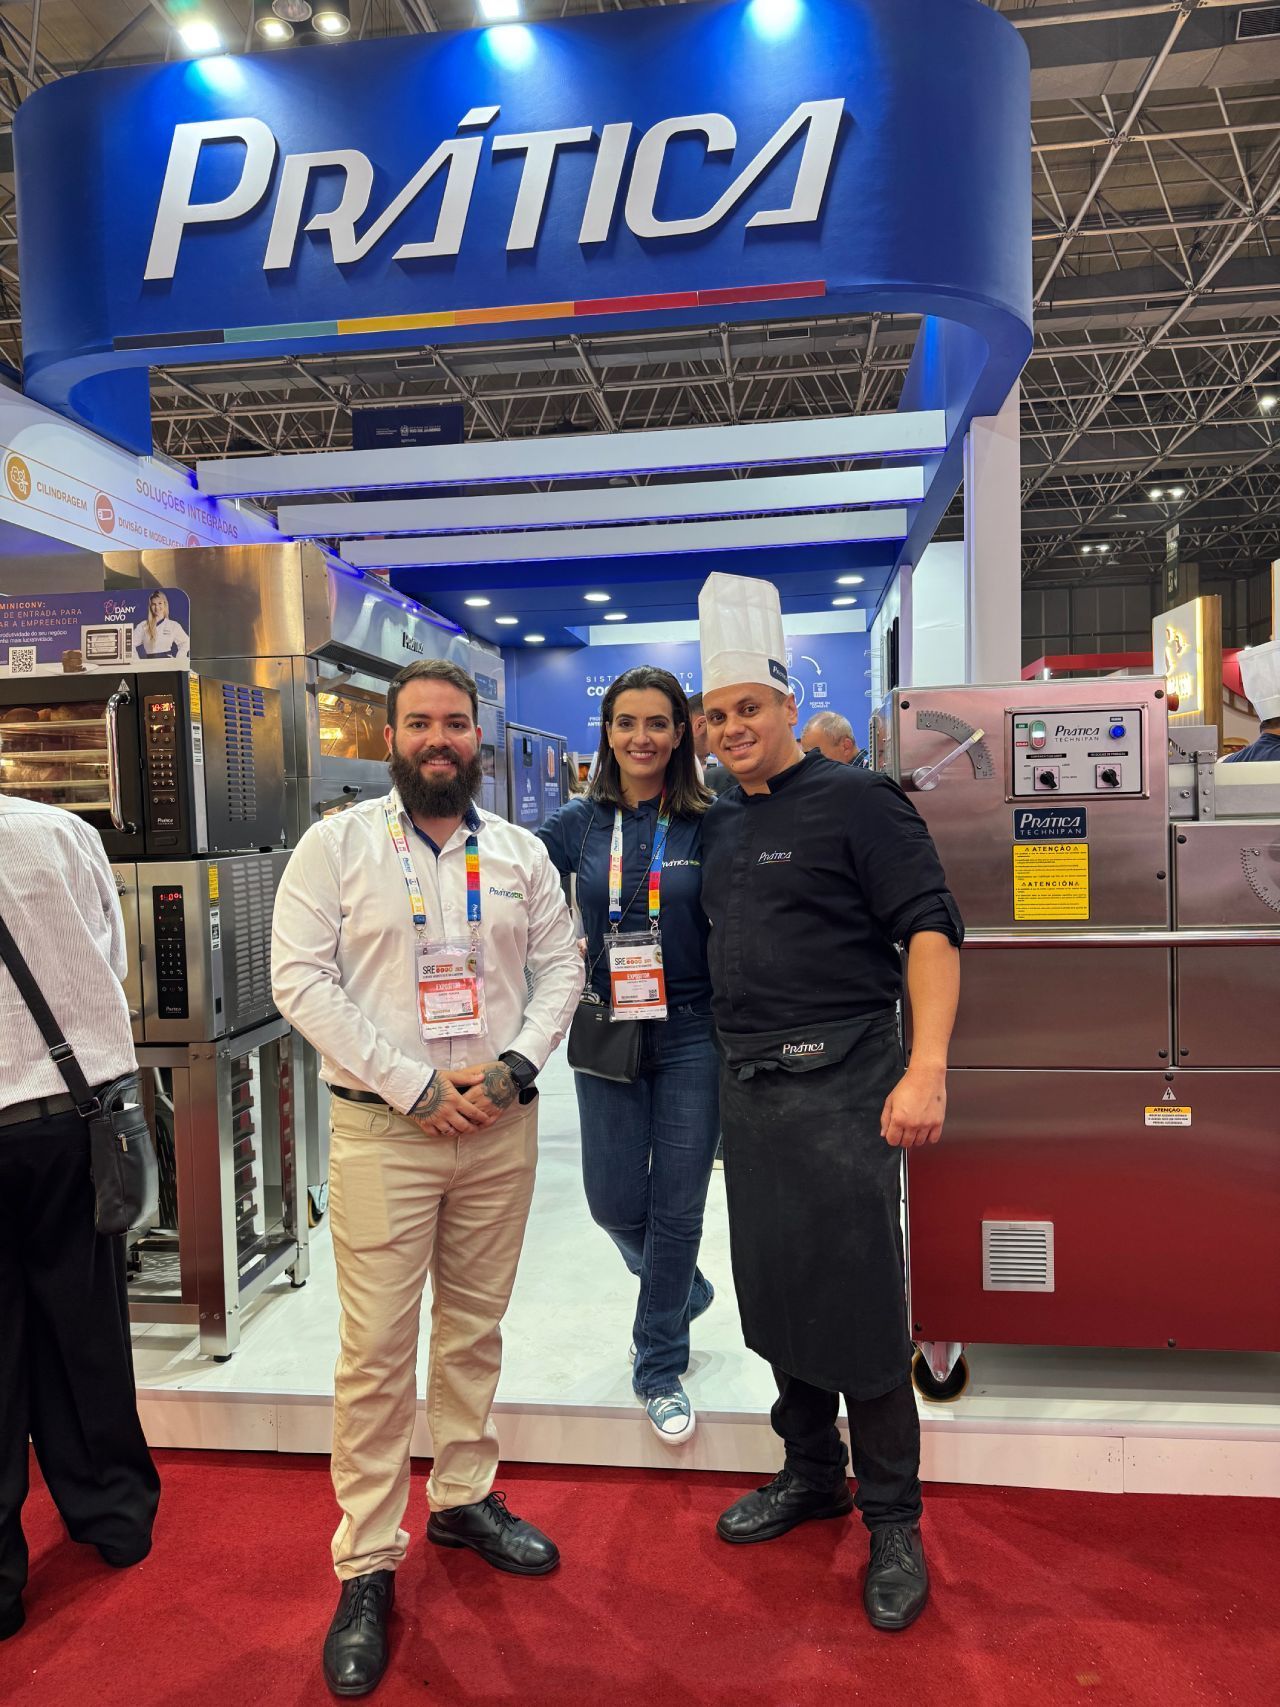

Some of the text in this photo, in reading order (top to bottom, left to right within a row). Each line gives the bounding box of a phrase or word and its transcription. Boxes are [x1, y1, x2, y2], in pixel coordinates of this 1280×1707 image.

[144, 97, 845, 280] PRÁTICA
[36, 481, 88, 512] CILINDRAGEM
[136, 478, 238, 539] SOLUÇÕES INTEGRADAS
[118, 516, 142, 536] DIVISÃO
[4, 611, 14, 619] DE
[17, 610, 56, 619] ENTRADA
[114, 606, 136, 614] DANY
[21, 618, 78, 627] EMPREENDER
[104, 612, 126, 622] NOVO
[1020, 812, 1080, 828] PRÁTICA
[758, 851, 792, 863] PRÁTICA
[423, 965, 435, 974] SRE
[782, 1042, 824, 1055] PRÁTICA
